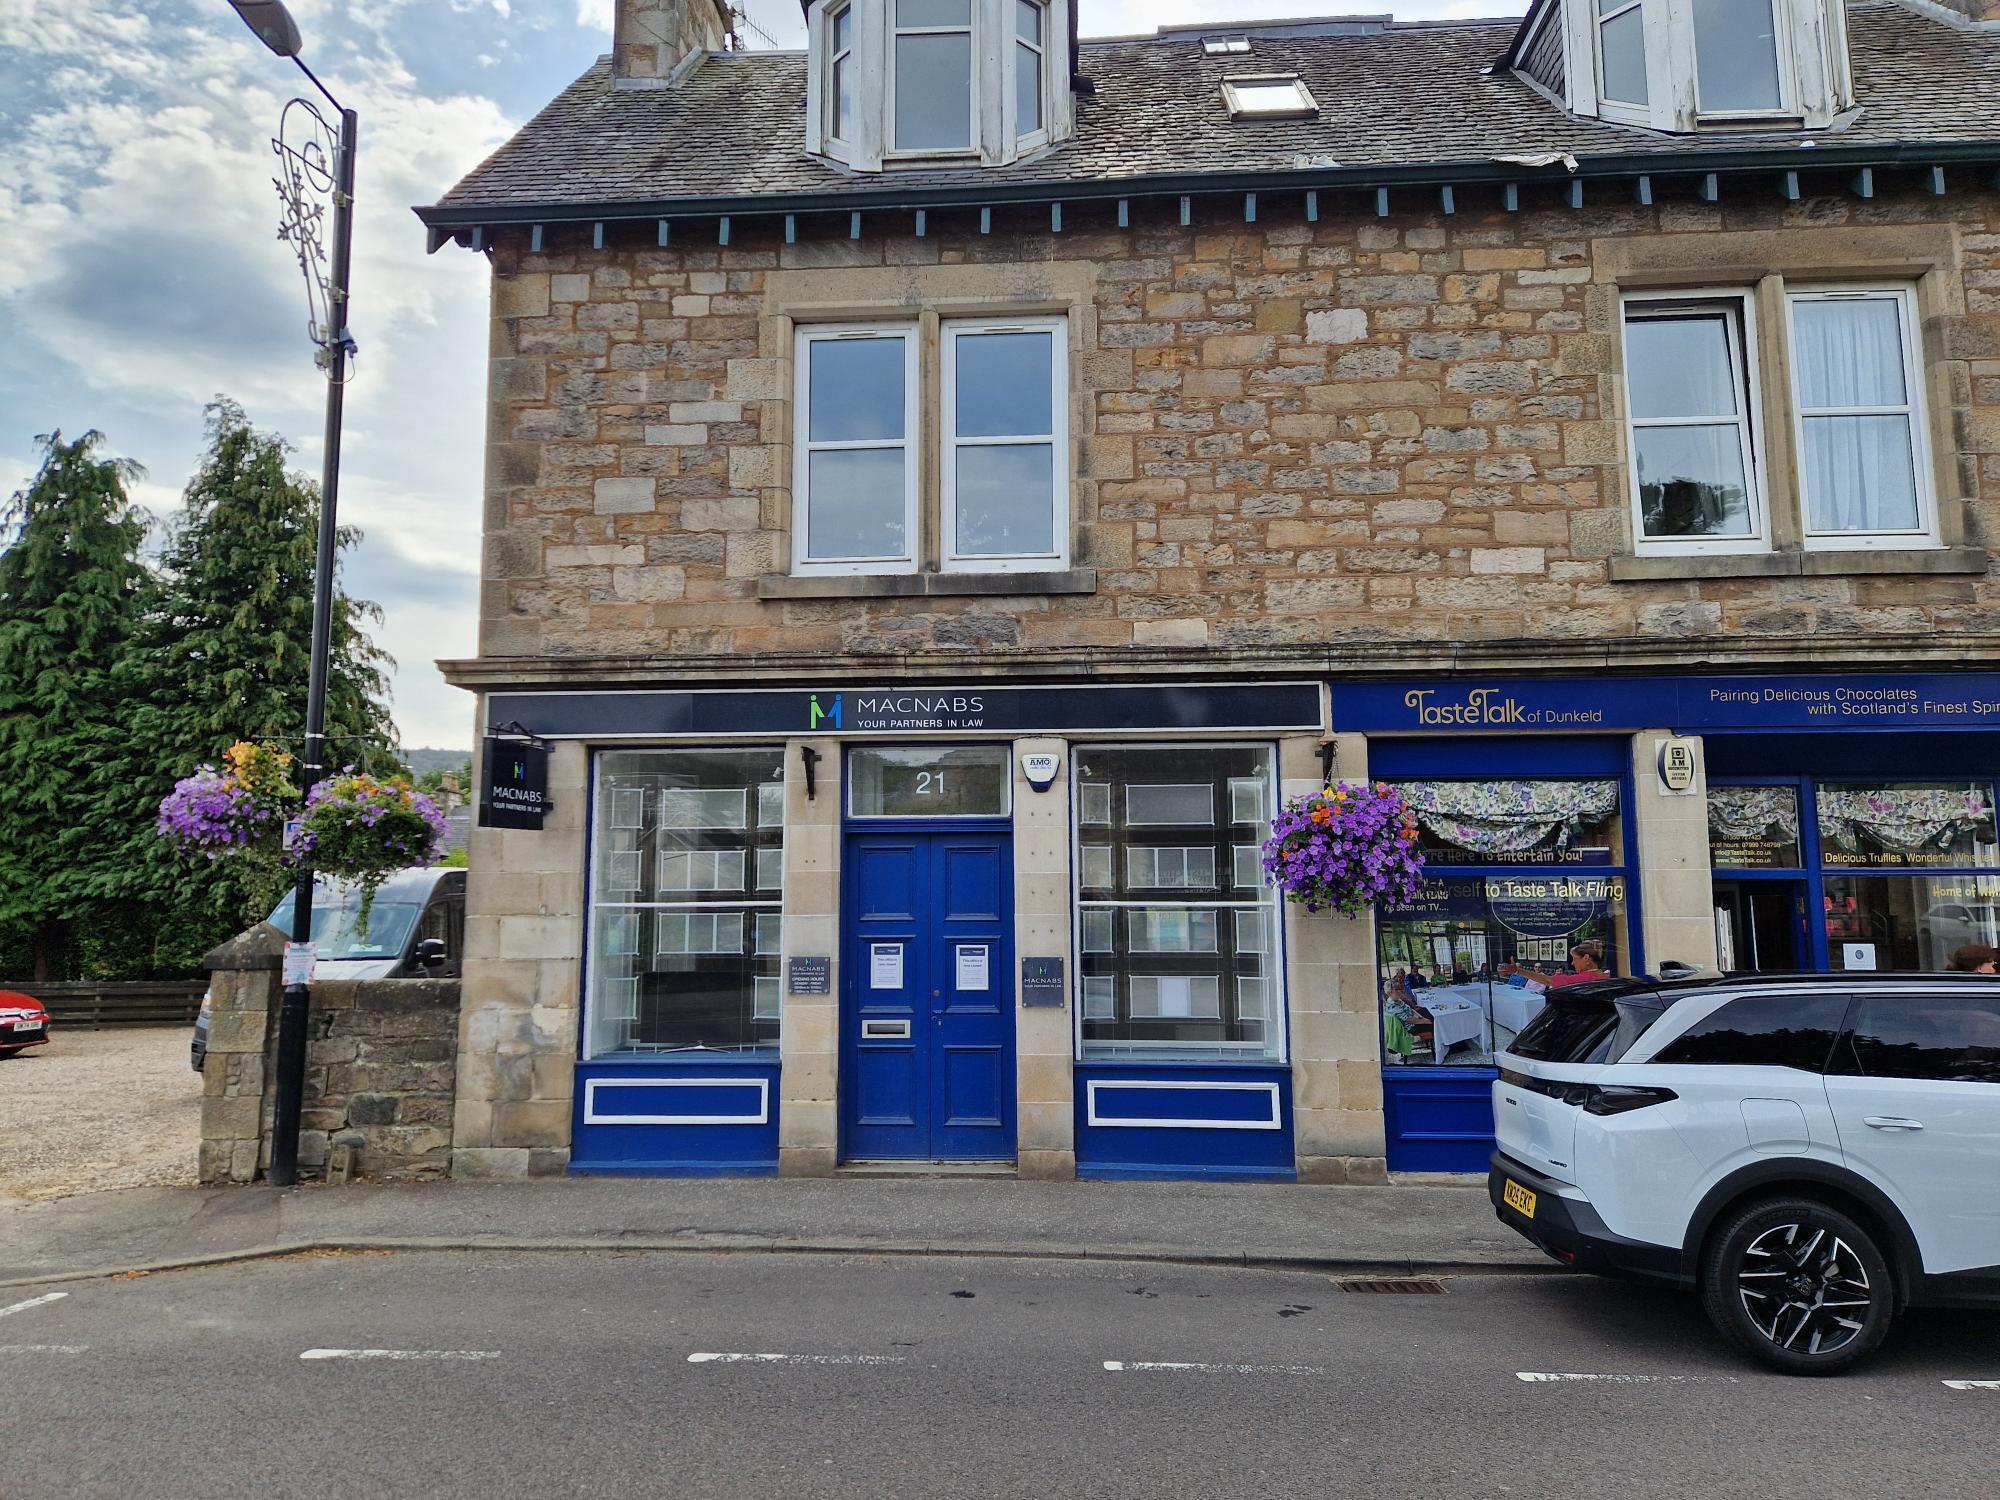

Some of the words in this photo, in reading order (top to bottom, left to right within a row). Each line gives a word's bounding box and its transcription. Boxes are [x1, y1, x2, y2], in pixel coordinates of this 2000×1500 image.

[1710, 689, 1760, 703] Pairing
[1764, 688, 1831, 701] Delicious
[1835, 687, 1918, 701] Chocolates
[857, 697, 984, 713] MACNABS
[1807, 703, 1837, 715] with
[1841, 702, 1919, 715] Scotland's
[1923, 701, 1968, 714] Finest
[857, 720, 886, 728] YOUR
[890, 719, 943, 728] PARTNERS
[947, 719, 958, 727] IN
[962, 719, 984, 727] LAW
[1527, 711, 1542, 723] of
[1546, 710, 1602, 723] Dunkeld
[916, 771, 944, 794] 21
[493, 786, 542, 802] MACNABS
[1447, 849, 1475, 863] Here
[1497, 850, 1555, 862] Entertain
[1558, 850, 1583, 862] You!
[1825, 852, 1867, 863] Delicious
[1869, 852, 1901, 863] Truffles
[1906, 852, 1952, 863] Wonderful
[1485, 882, 1500, 897] to
[1505, 881, 1546, 897] Taste
[1550, 881, 1581, 897] Talk
[1586, 881, 1623, 901] Fling
[1933, 887, 1962, 897] Home
[1964, 884, 1976, 898] of
